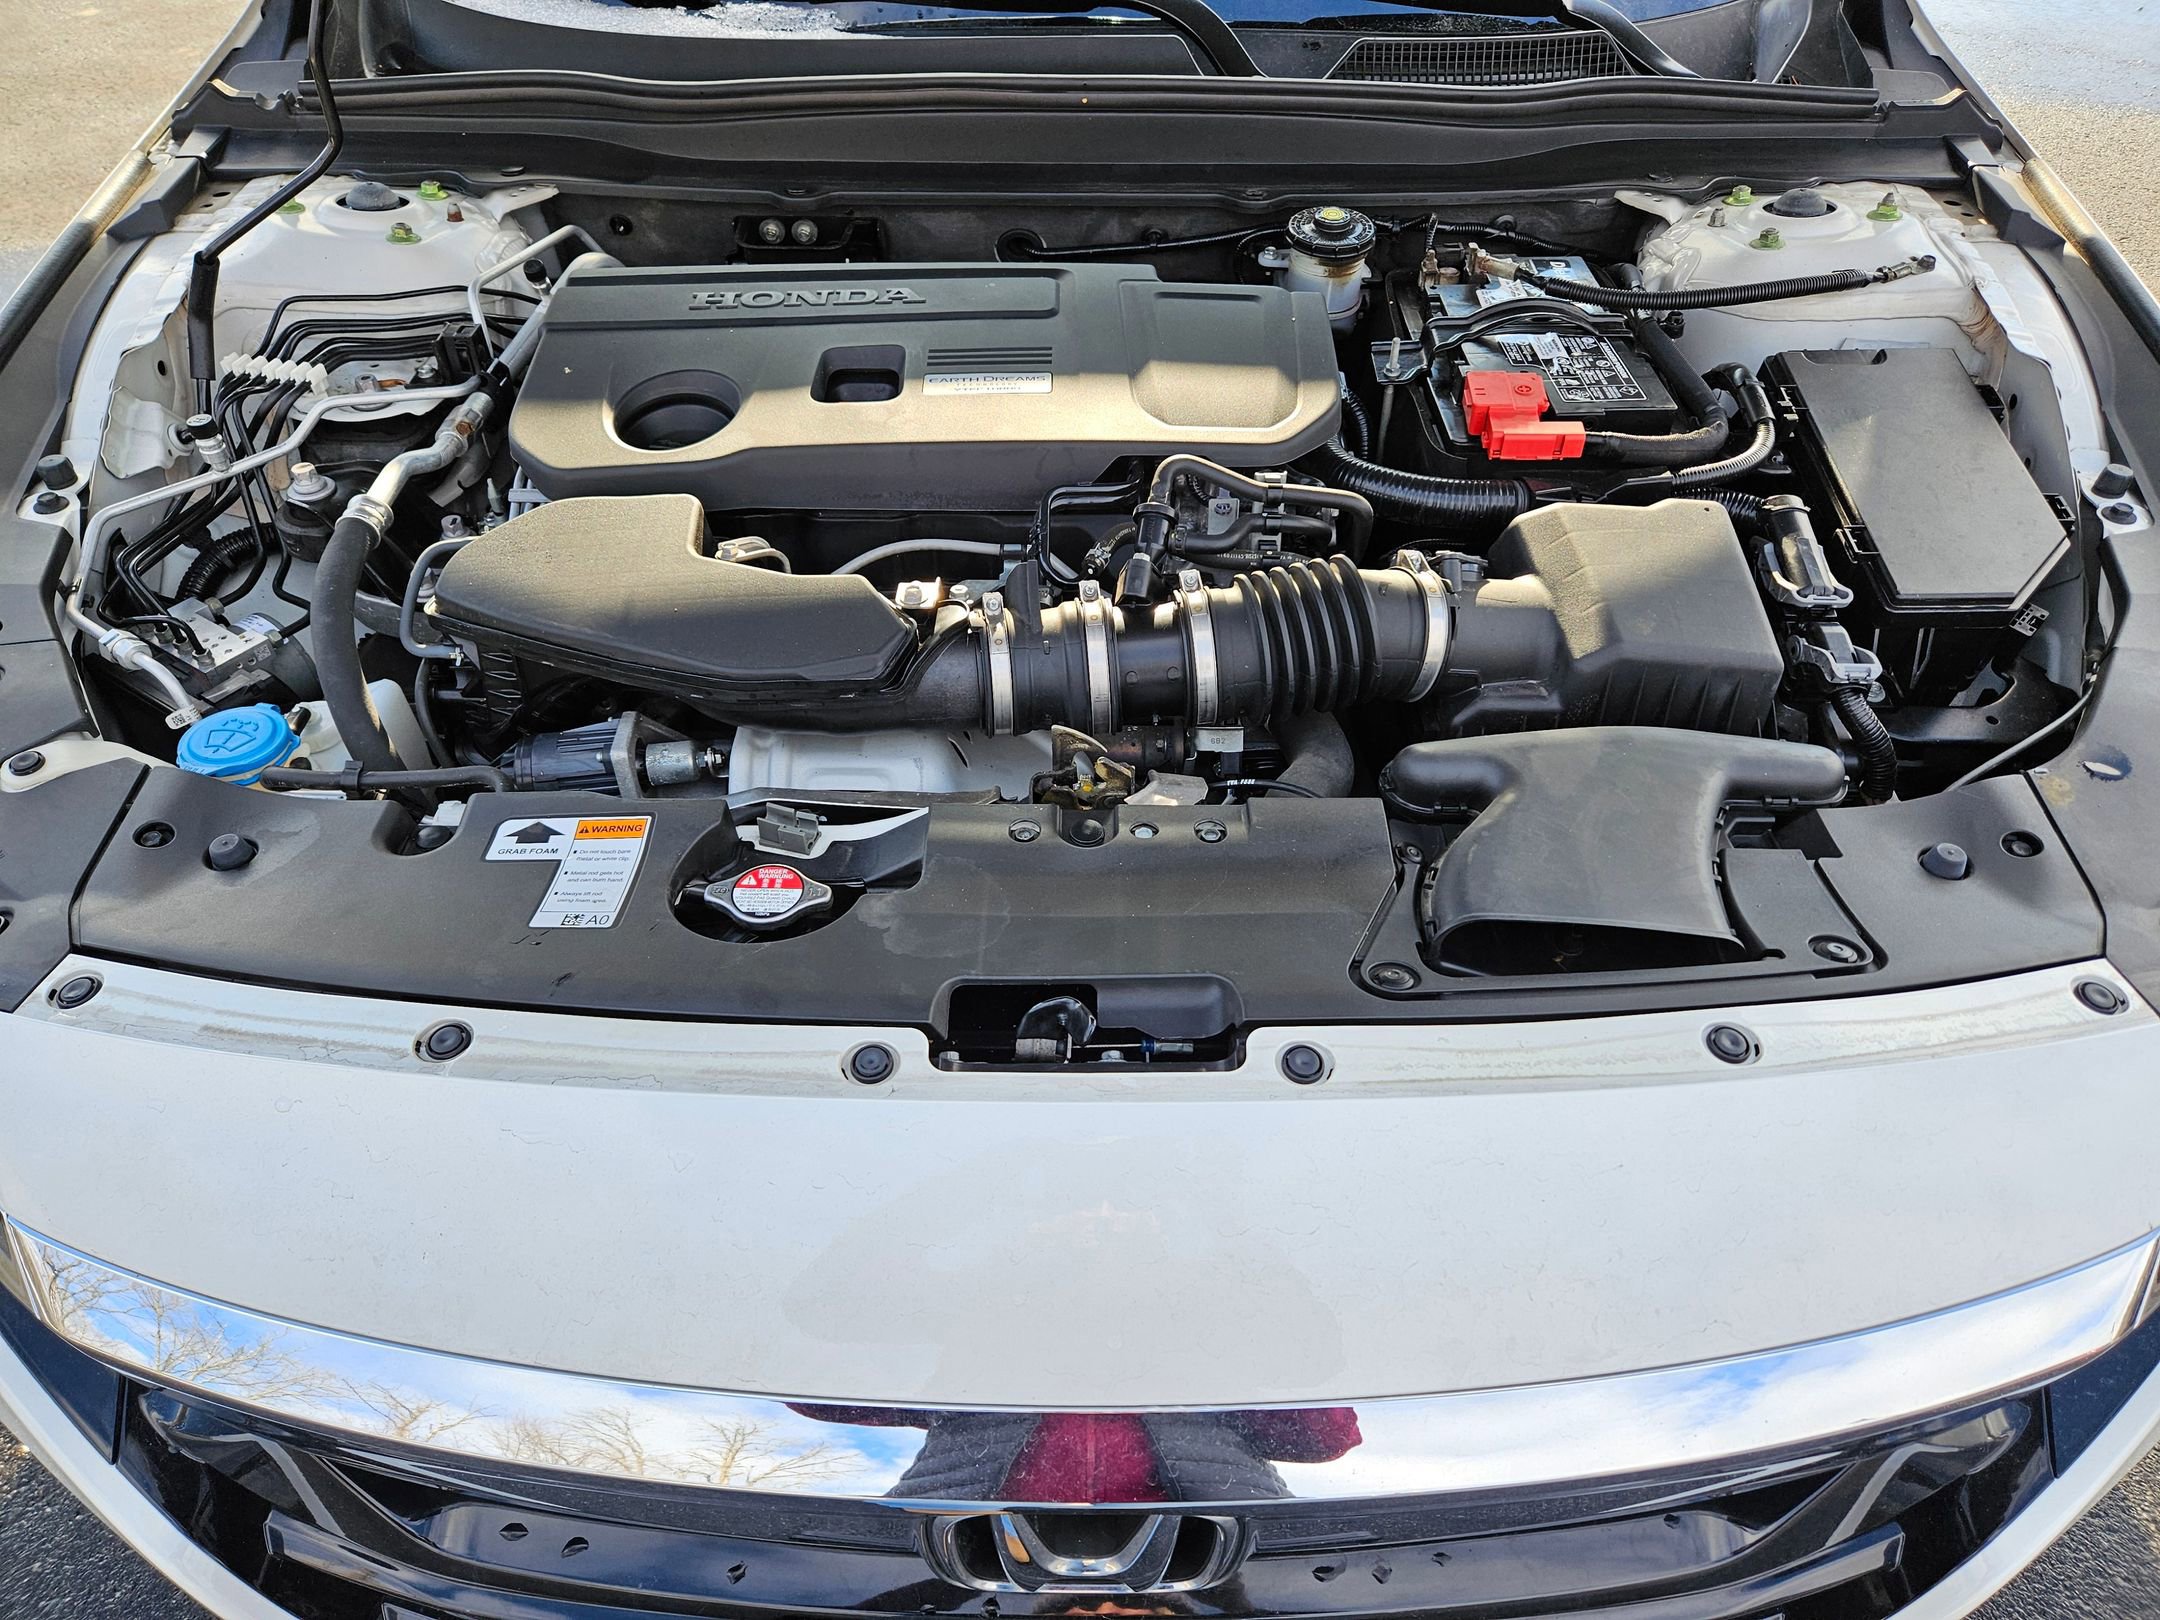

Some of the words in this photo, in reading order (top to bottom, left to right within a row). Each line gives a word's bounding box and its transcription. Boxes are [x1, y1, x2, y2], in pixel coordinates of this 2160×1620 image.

[689, 287, 927, 310] HONDA
[591, 824, 643, 834] WARNING
[529, 847, 559, 855] FOAM
[585, 914, 610, 925] A0
